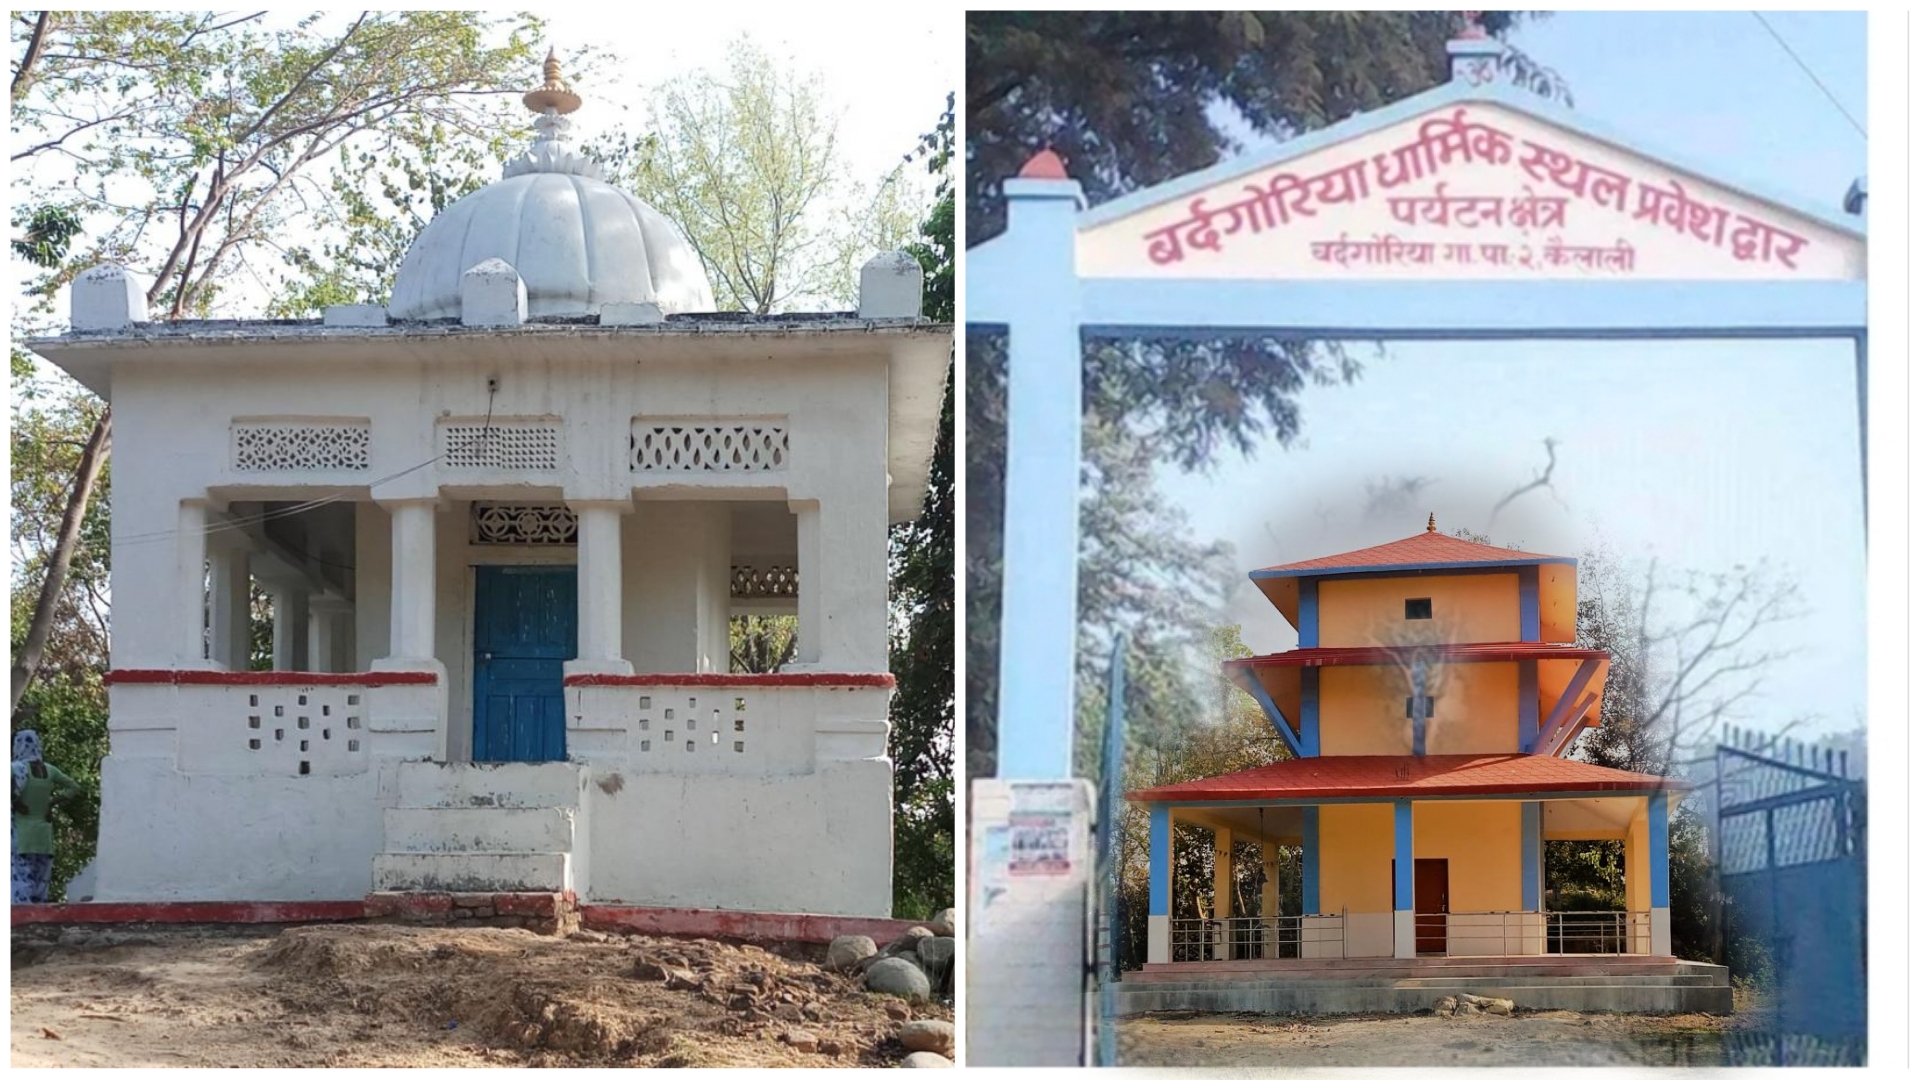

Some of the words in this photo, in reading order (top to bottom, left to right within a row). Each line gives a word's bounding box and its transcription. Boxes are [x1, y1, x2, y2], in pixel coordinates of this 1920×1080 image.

[1144, 160, 1369, 265] बर्दगोरिया
[1372, 109, 1513, 188] धार्मिक
[1518, 139, 1631, 213] स्थल
[1632, 180, 1730, 246] प्रवेश
[1730, 213, 1809, 270] द्वार
[1386, 182, 1504, 228] पर्यटन
[1508, 184, 1570, 228] क्षेत्र
